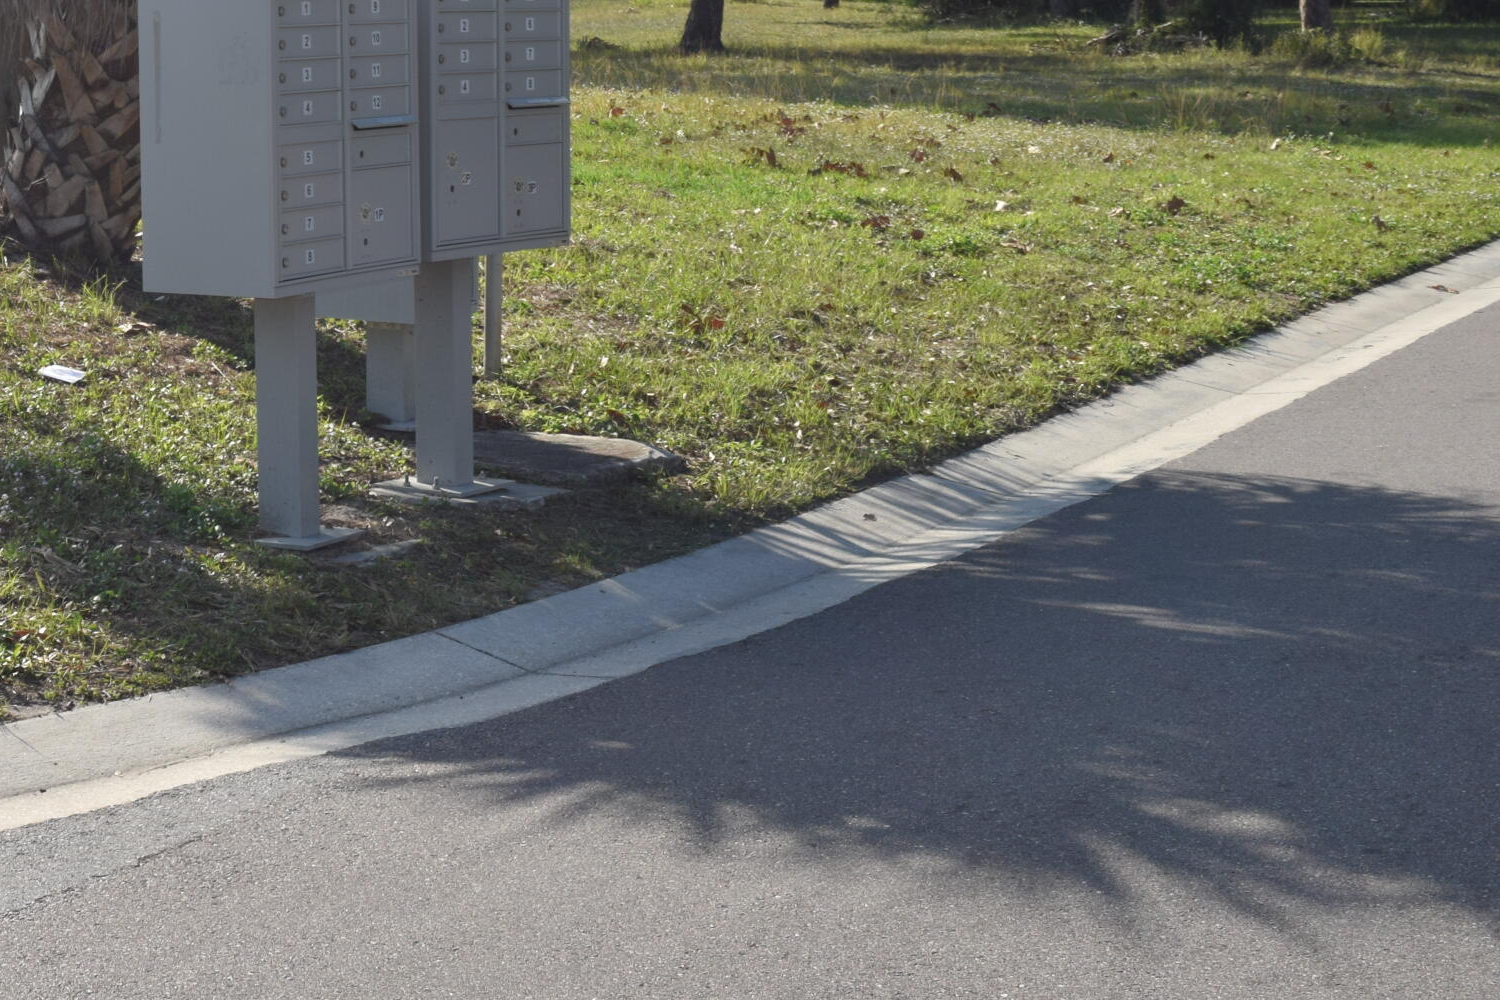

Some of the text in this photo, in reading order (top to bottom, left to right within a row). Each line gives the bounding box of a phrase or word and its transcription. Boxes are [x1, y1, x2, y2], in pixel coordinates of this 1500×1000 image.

[372, 33, 380, 43] 10
[372, 65, 380, 76] 11
[373, 97, 381, 108] 12
[375, 209, 383, 220] 1P
